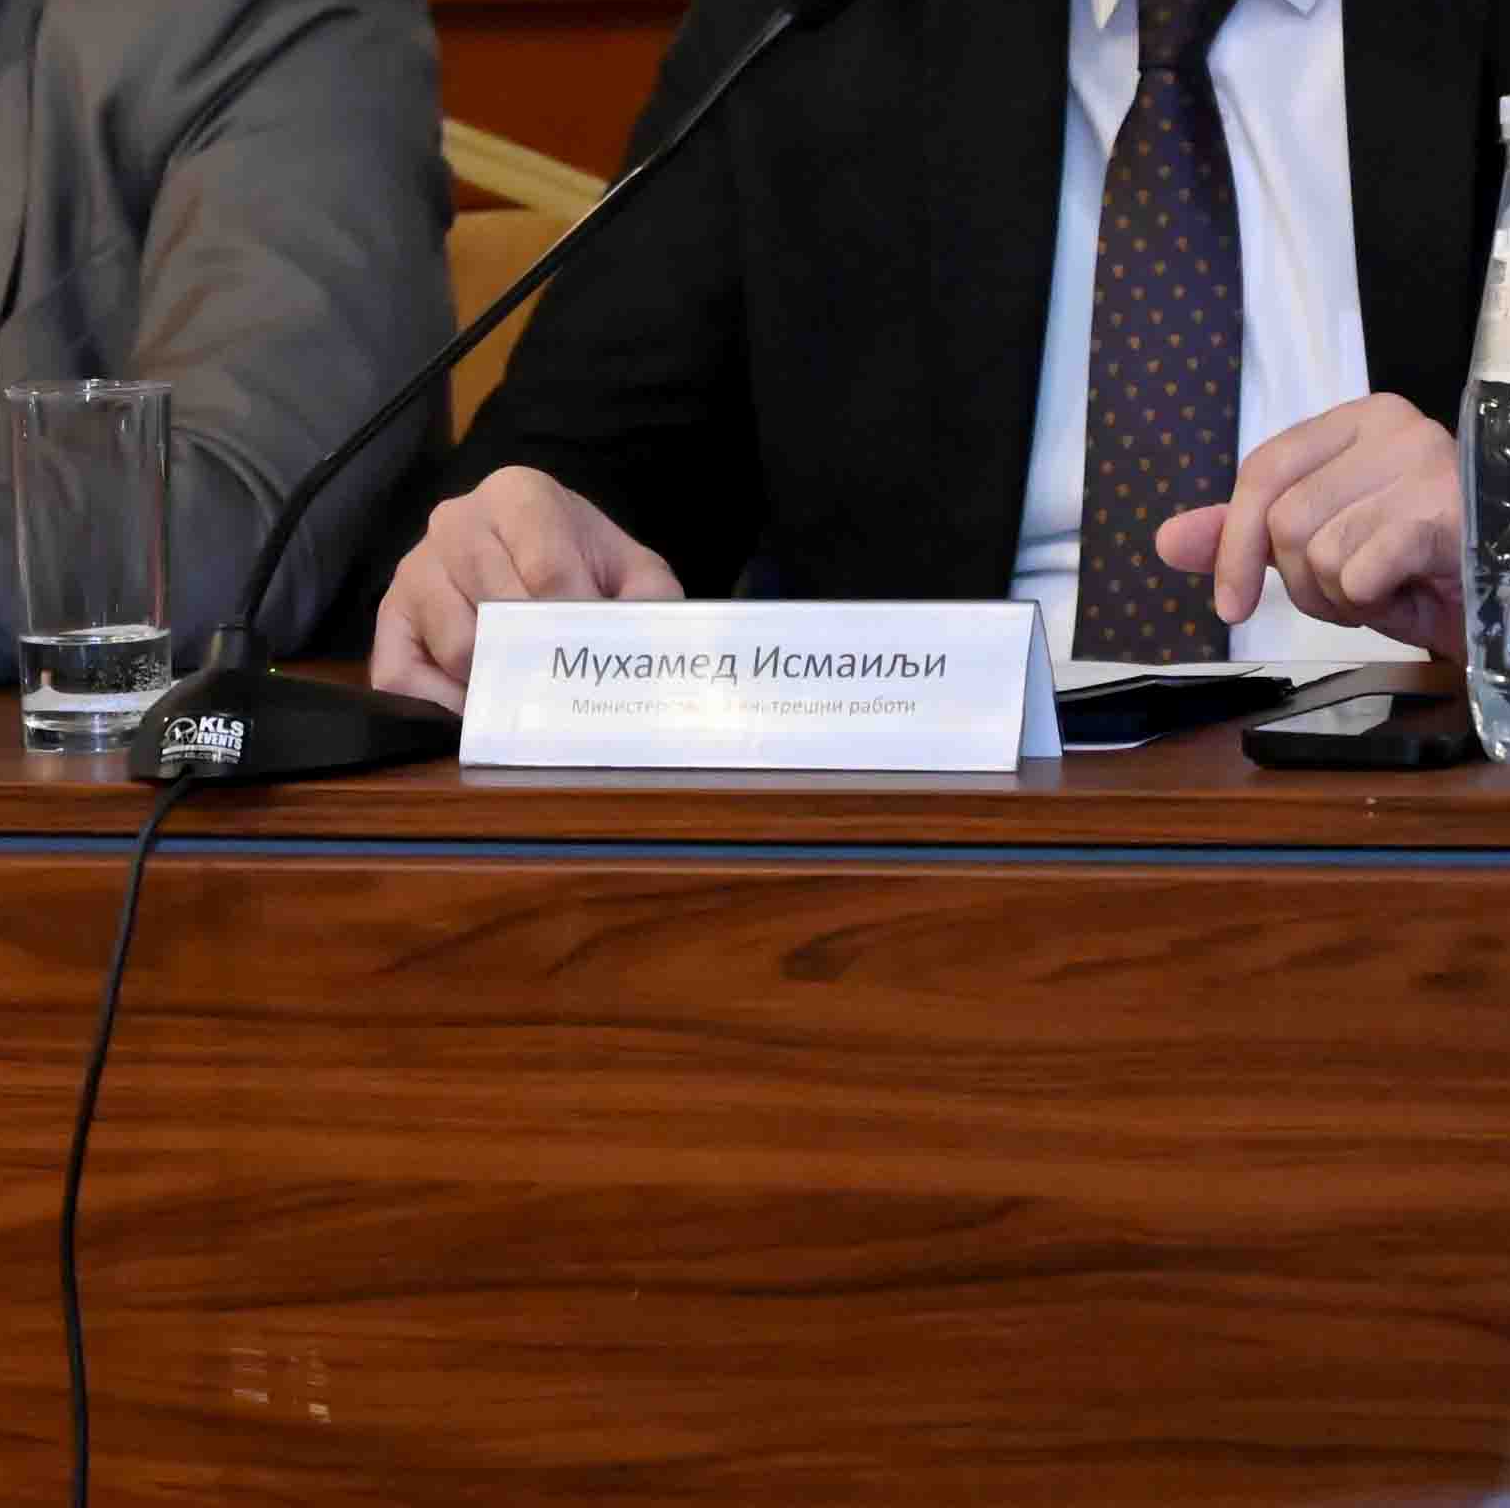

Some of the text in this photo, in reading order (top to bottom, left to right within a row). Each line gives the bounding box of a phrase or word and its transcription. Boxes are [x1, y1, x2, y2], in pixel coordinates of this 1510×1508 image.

[552, 646, 947, 686] Мухамед Исмаиљи
[848, 695, 916, 717] работи
[199, 716, 244, 738] KLS
[196, 731, 243, 750] EVENTS
